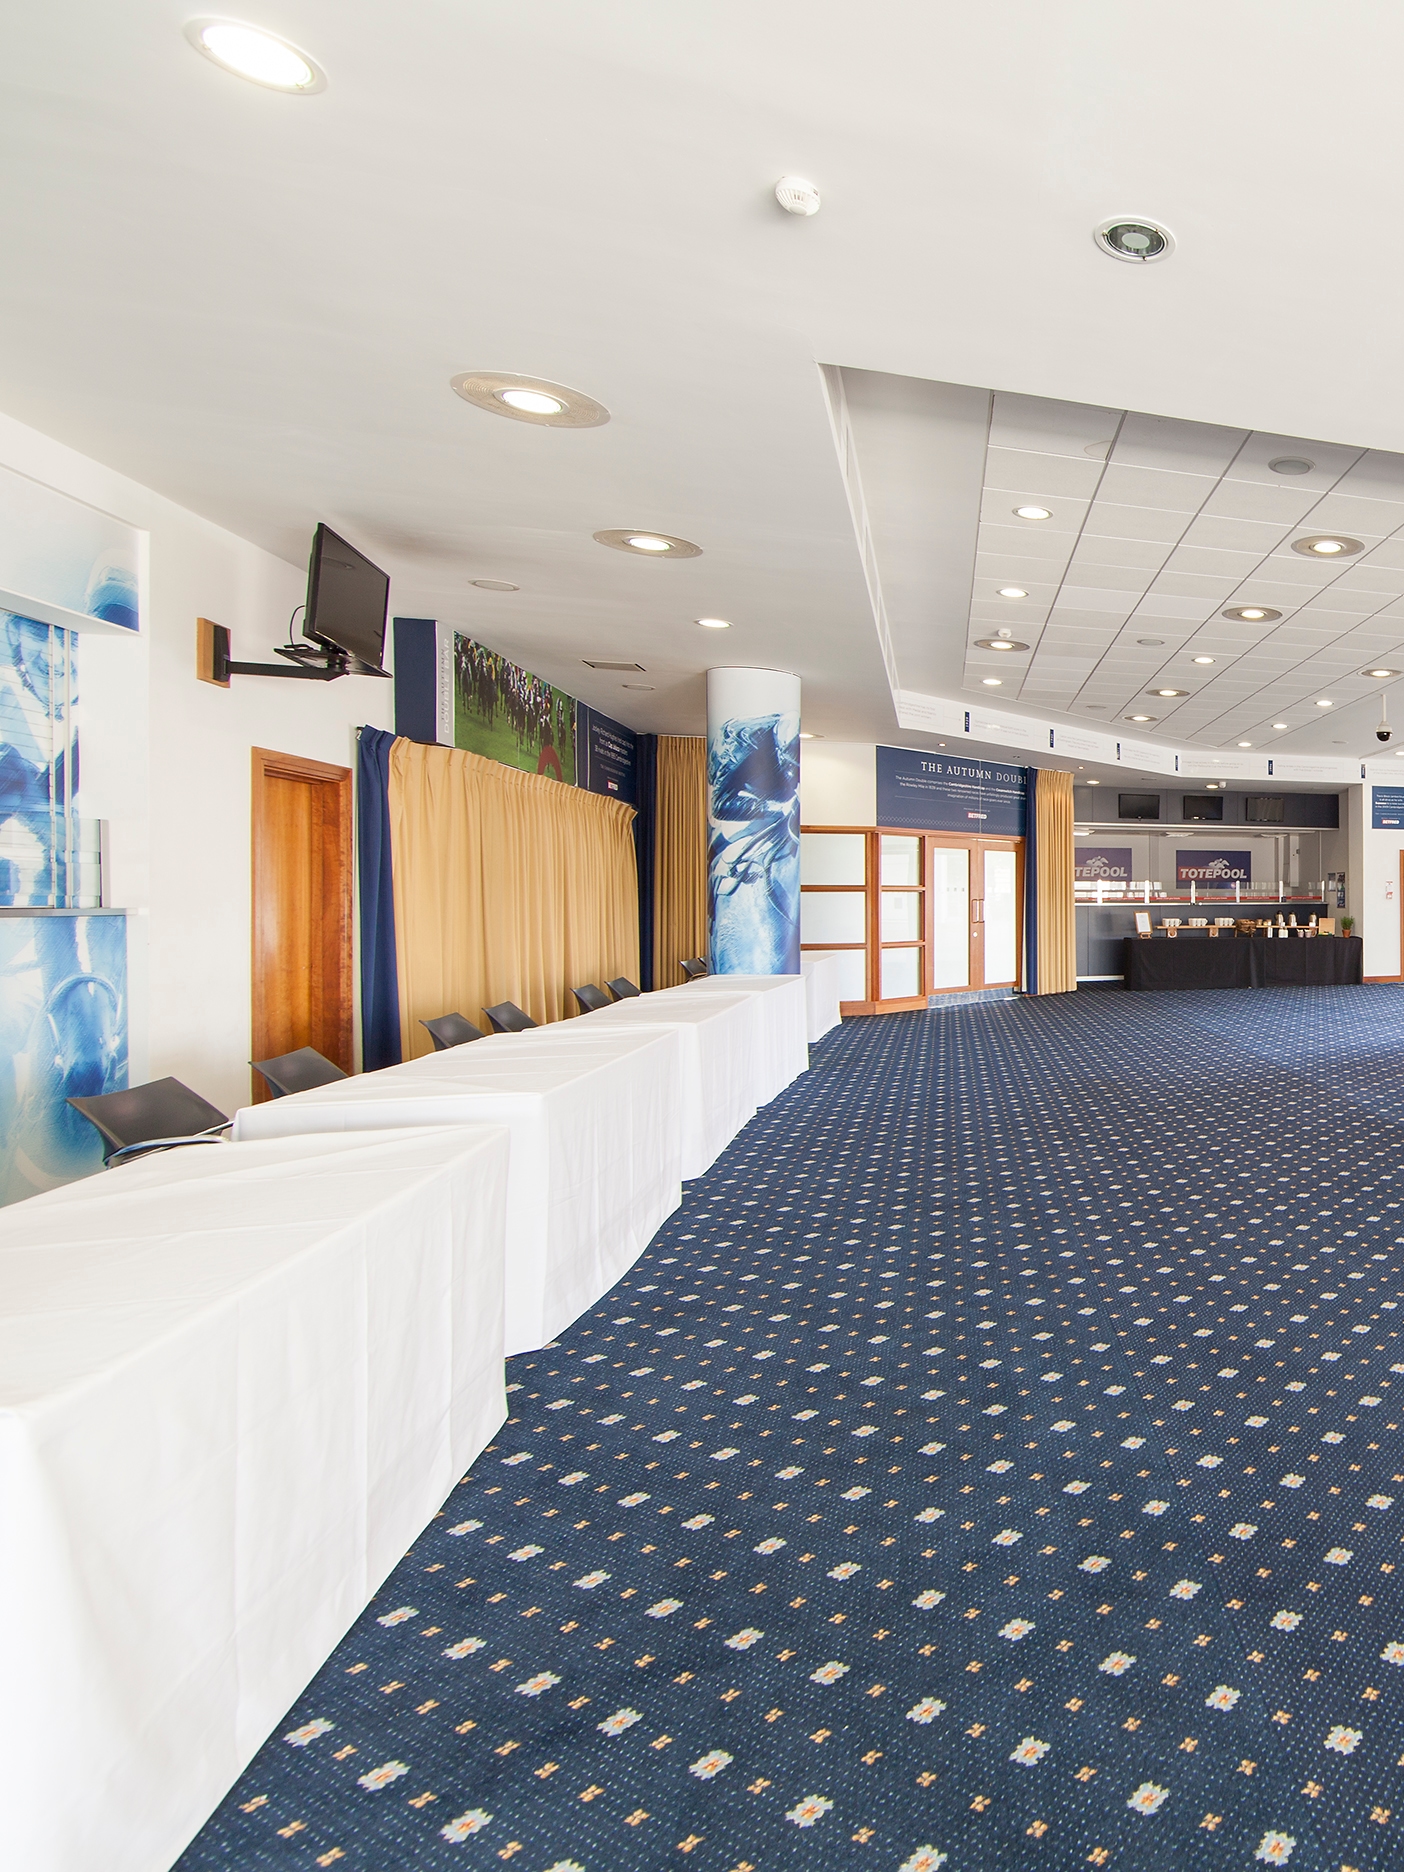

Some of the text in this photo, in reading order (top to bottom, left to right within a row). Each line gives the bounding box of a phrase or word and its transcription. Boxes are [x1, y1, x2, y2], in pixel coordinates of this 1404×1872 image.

[920, 761, 1027, 785] THE AUTUMN DOUBL
[1074, 866, 1128, 877] TEPOOL
[1180, 868, 1247, 879] TOTEPOOL
